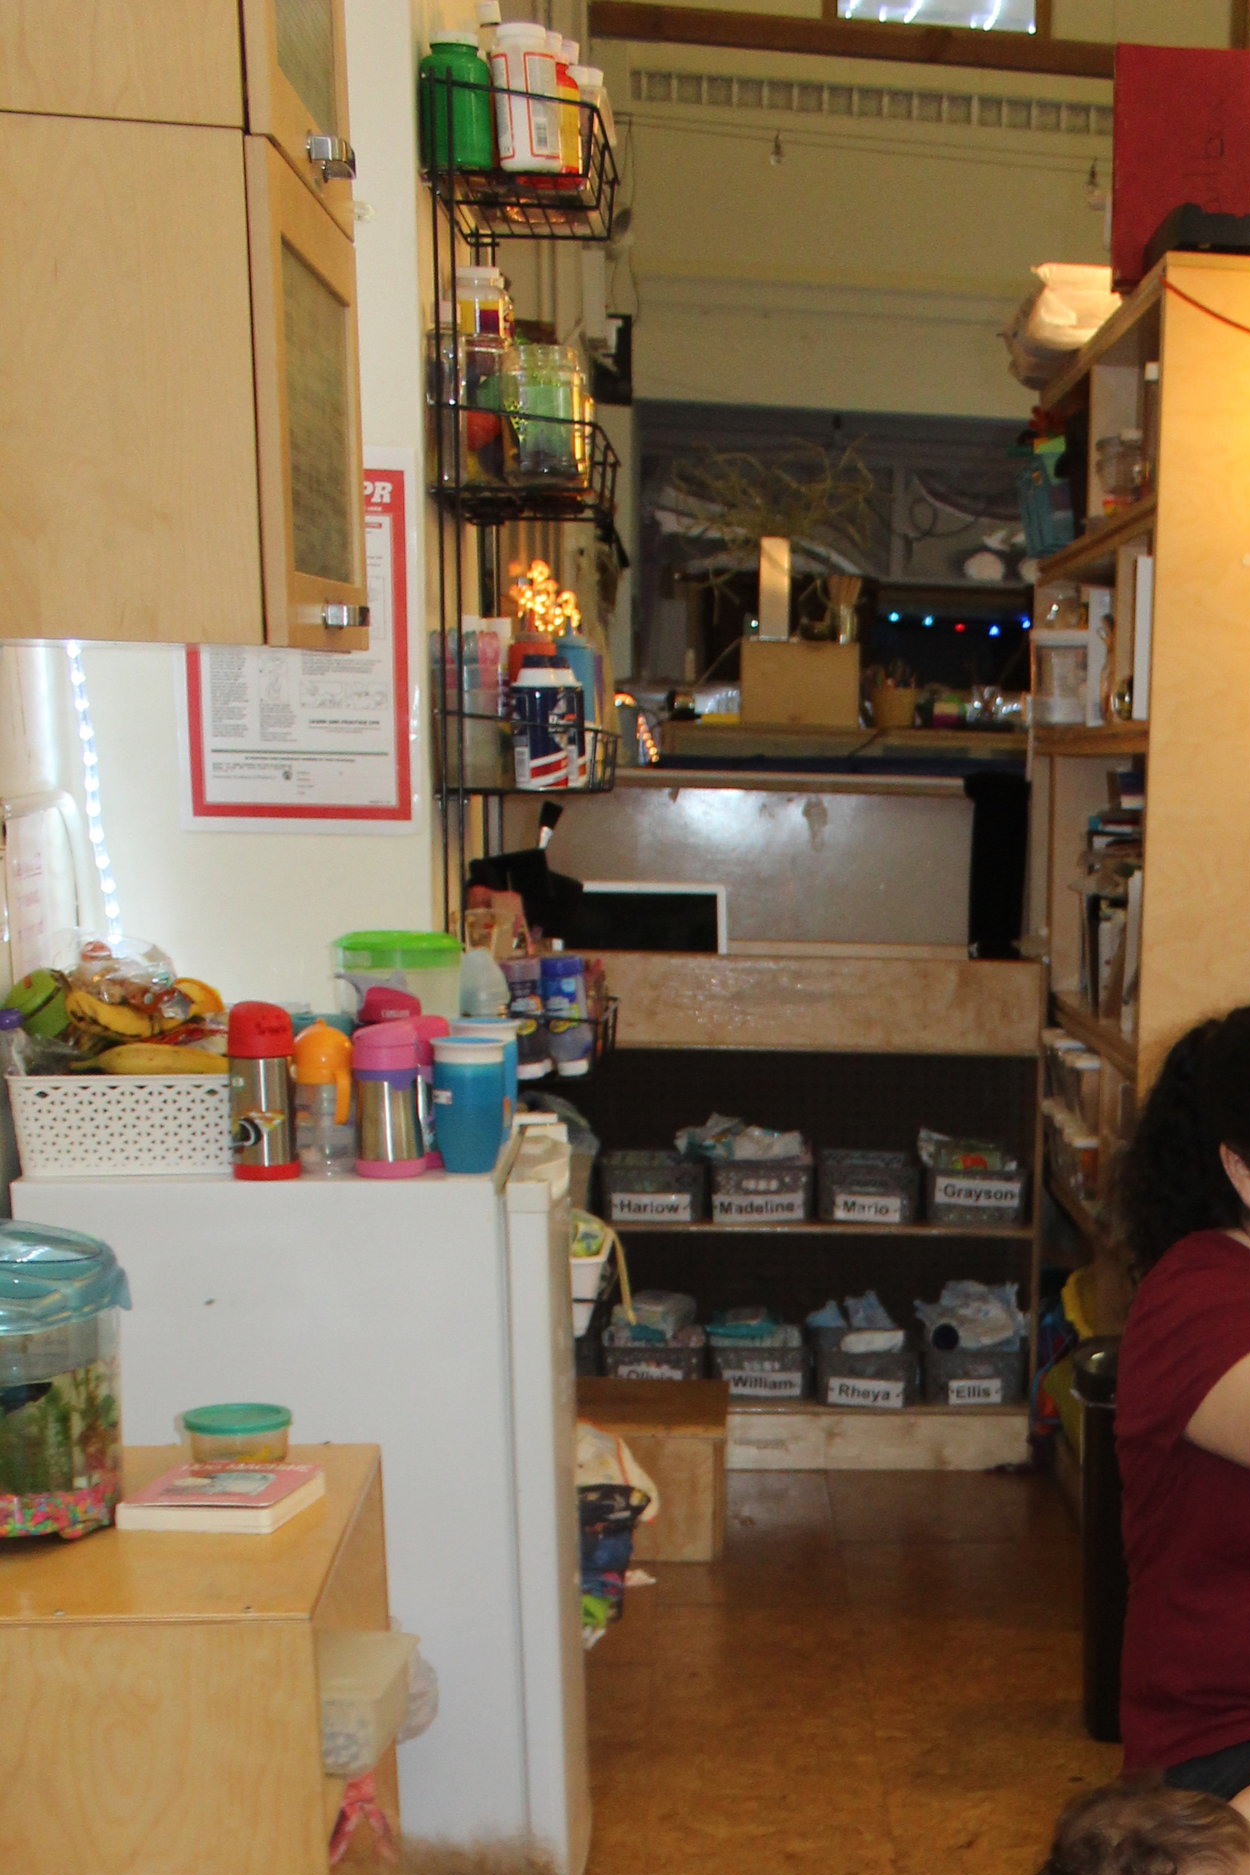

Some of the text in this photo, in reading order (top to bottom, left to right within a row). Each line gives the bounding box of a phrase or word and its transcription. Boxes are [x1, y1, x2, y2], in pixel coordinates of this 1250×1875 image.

[363, 481, 393, 504] PR
[943, 1183, 1013, 1202] Grayson
[619, 1200, 680, 1214] Harlow
[719, 1200, 795, 1215] Madeline
[842, 1201, 889, 1215] Mario
[732, 1375, 792, 1390] William
[838, 1383, 890, 1401] Rheya
[955, 1385, 991, 1398] Ellis
